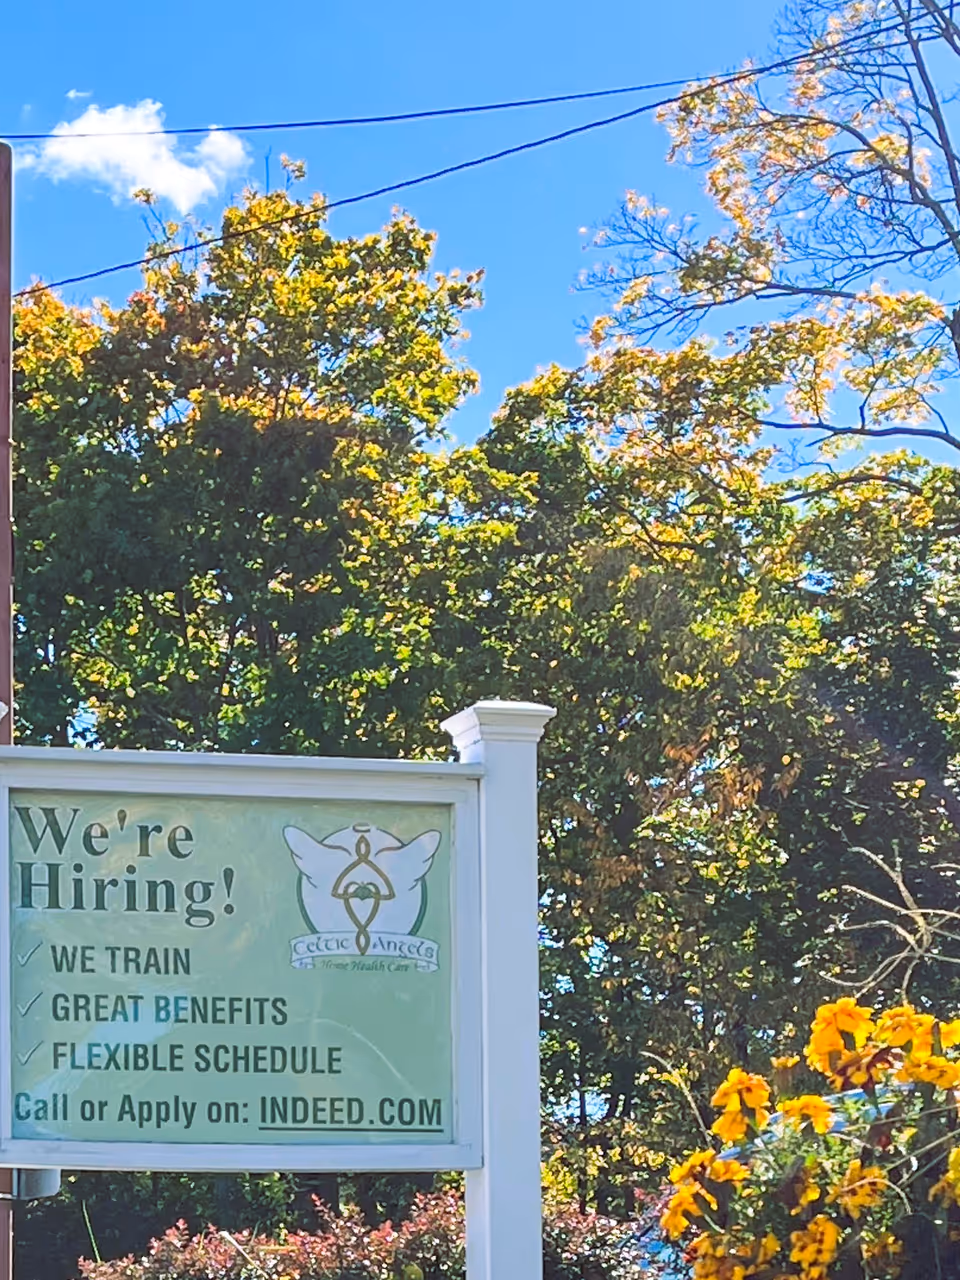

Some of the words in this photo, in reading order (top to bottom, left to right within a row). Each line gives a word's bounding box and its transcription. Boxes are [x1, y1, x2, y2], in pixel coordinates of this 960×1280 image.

[14, 806, 194, 859] We're
[16, 862, 236, 928] Hiring!
[51, 945, 95, 974] WE
[104, 946, 191, 976] TRAIN
[293, 936, 349, 956] Celtic
[372, 936, 435, 959] Angels
[52, 993, 144, 1023] GREAT
[154, 996, 288, 1025] BENEFITS
[52, 1042, 184, 1072] FLEXIBLE
[194, 1044, 342, 1075] SCHEDULE
[14, 1092, 69, 1121] Call
[80, 1099, 108, 1122] or
[117, 1094, 196, 1129] Apply
[207, 1100, 249, 1124] on:
[259, 1096, 442, 1127] INDEED.COM
